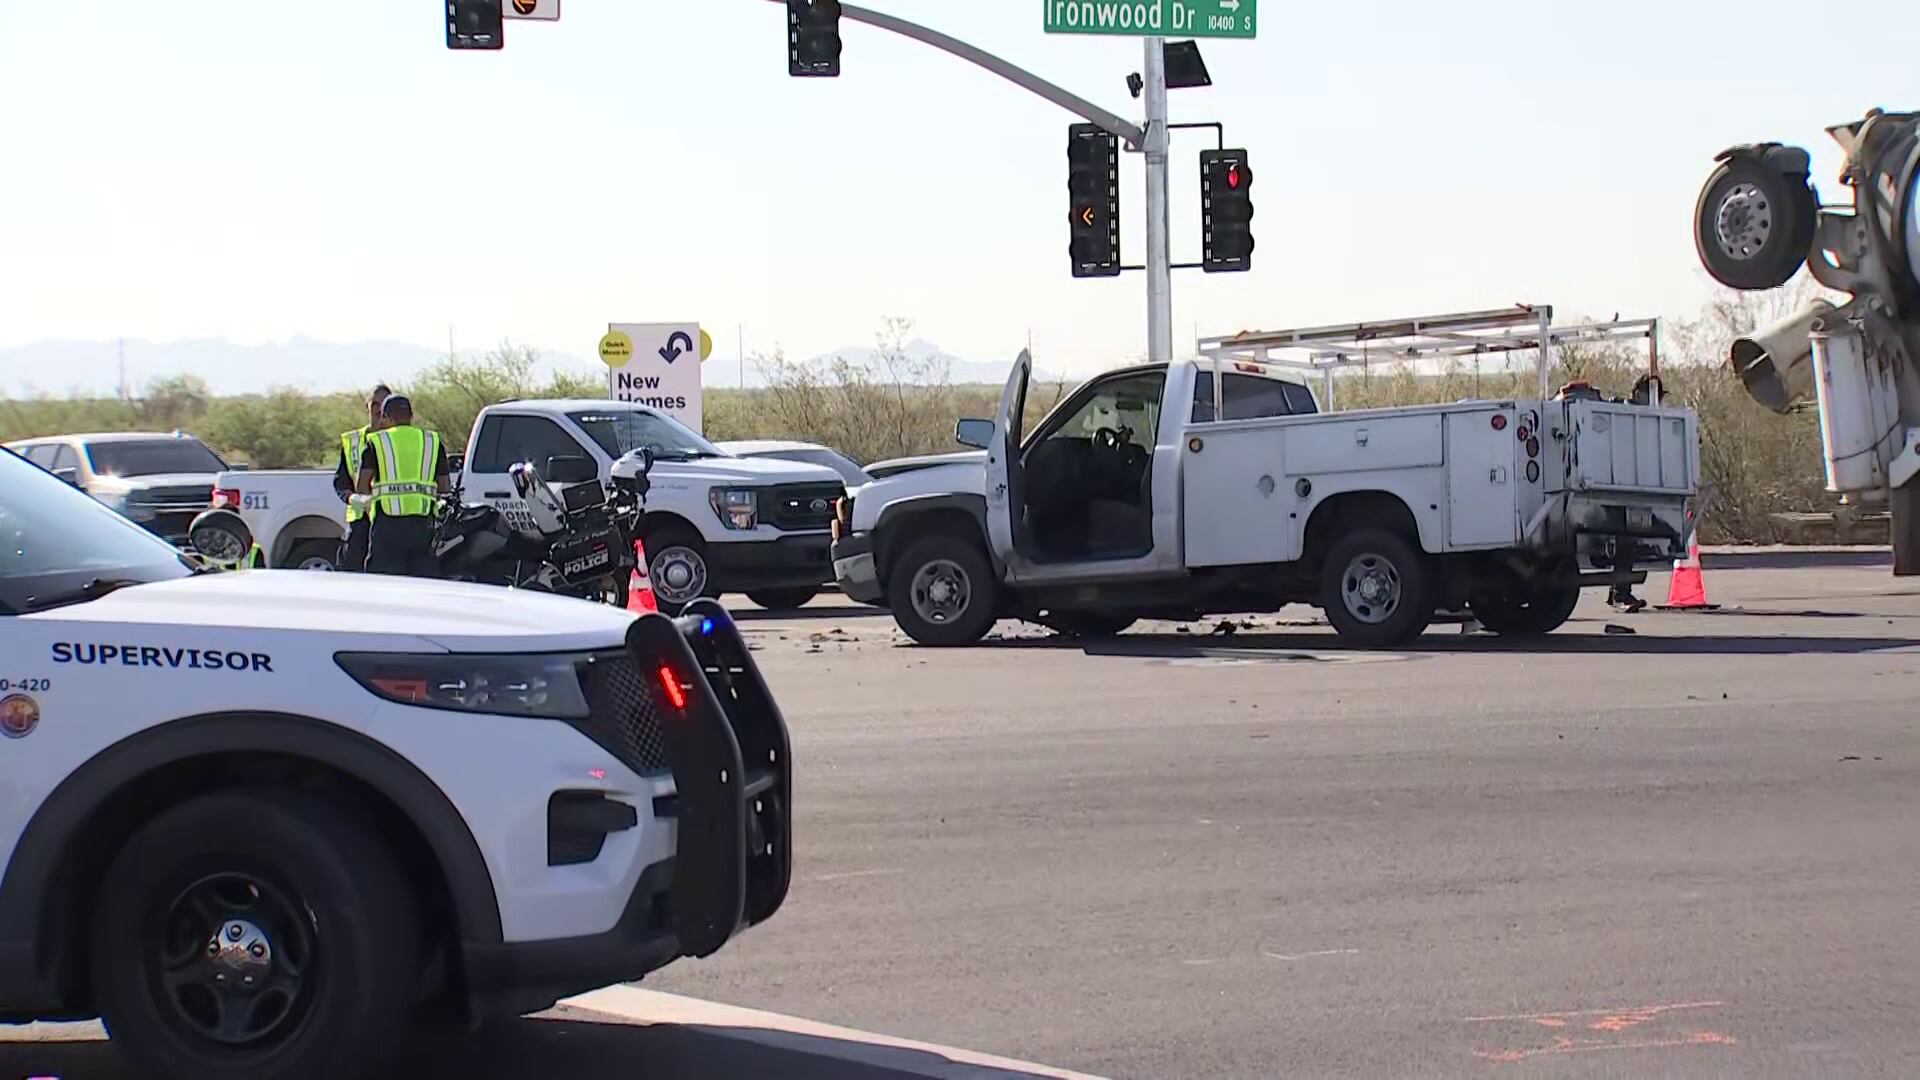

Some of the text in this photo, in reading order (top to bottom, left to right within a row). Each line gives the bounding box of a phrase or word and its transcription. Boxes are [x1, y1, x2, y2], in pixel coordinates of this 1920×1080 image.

[1047, 0, 1195, 30] Ironwood Dr
[1208, 15, 1251, 30] 10400 S
[618, 373, 660, 389] New
[244, 495, 270, 510] 911
[494, 500, 529, 511] Apach
[564, 552, 609, 576] POLICE
[52, 642, 274, 673] SUPERVISOR
